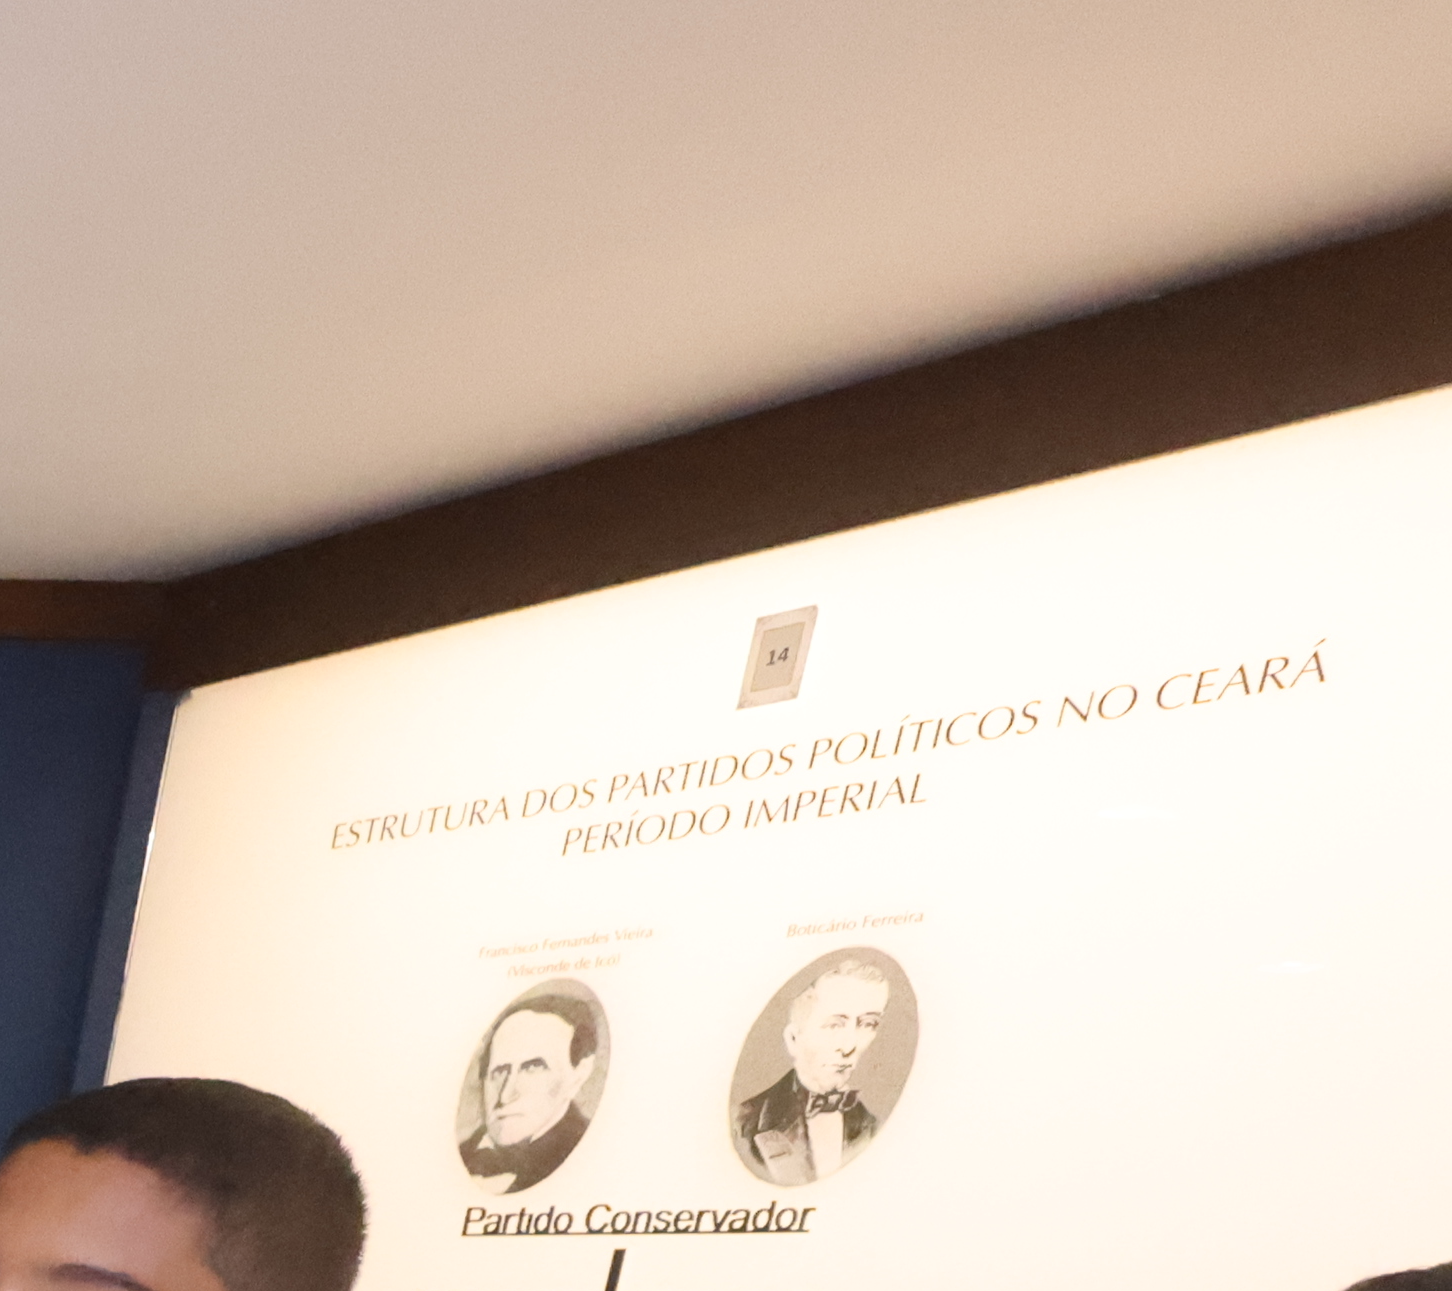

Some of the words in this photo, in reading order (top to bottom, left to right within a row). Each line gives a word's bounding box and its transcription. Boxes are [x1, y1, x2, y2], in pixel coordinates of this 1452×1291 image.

[765, 647, 790, 667] 14
[330, 796, 511, 850] ESTRUTURA
[521, 778, 599, 820] DOS
[607, 742, 797, 804] PARTIDOS
[807, 700, 1042, 770] POLÍTICOS
[1056, 684, 1138, 728] NO
[1156, 638, 1328, 711] CEARÁ
[561, 803, 731, 857] PERÍODO
[743, 773, 927, 829] IMPERIAL
[786, 917, 857, 939] Boticário
[862, 909, 925, 929] Ferreira
[461, 1205, 574, 1236] Partido
[584, 1200, 817, 1234] Conservador
